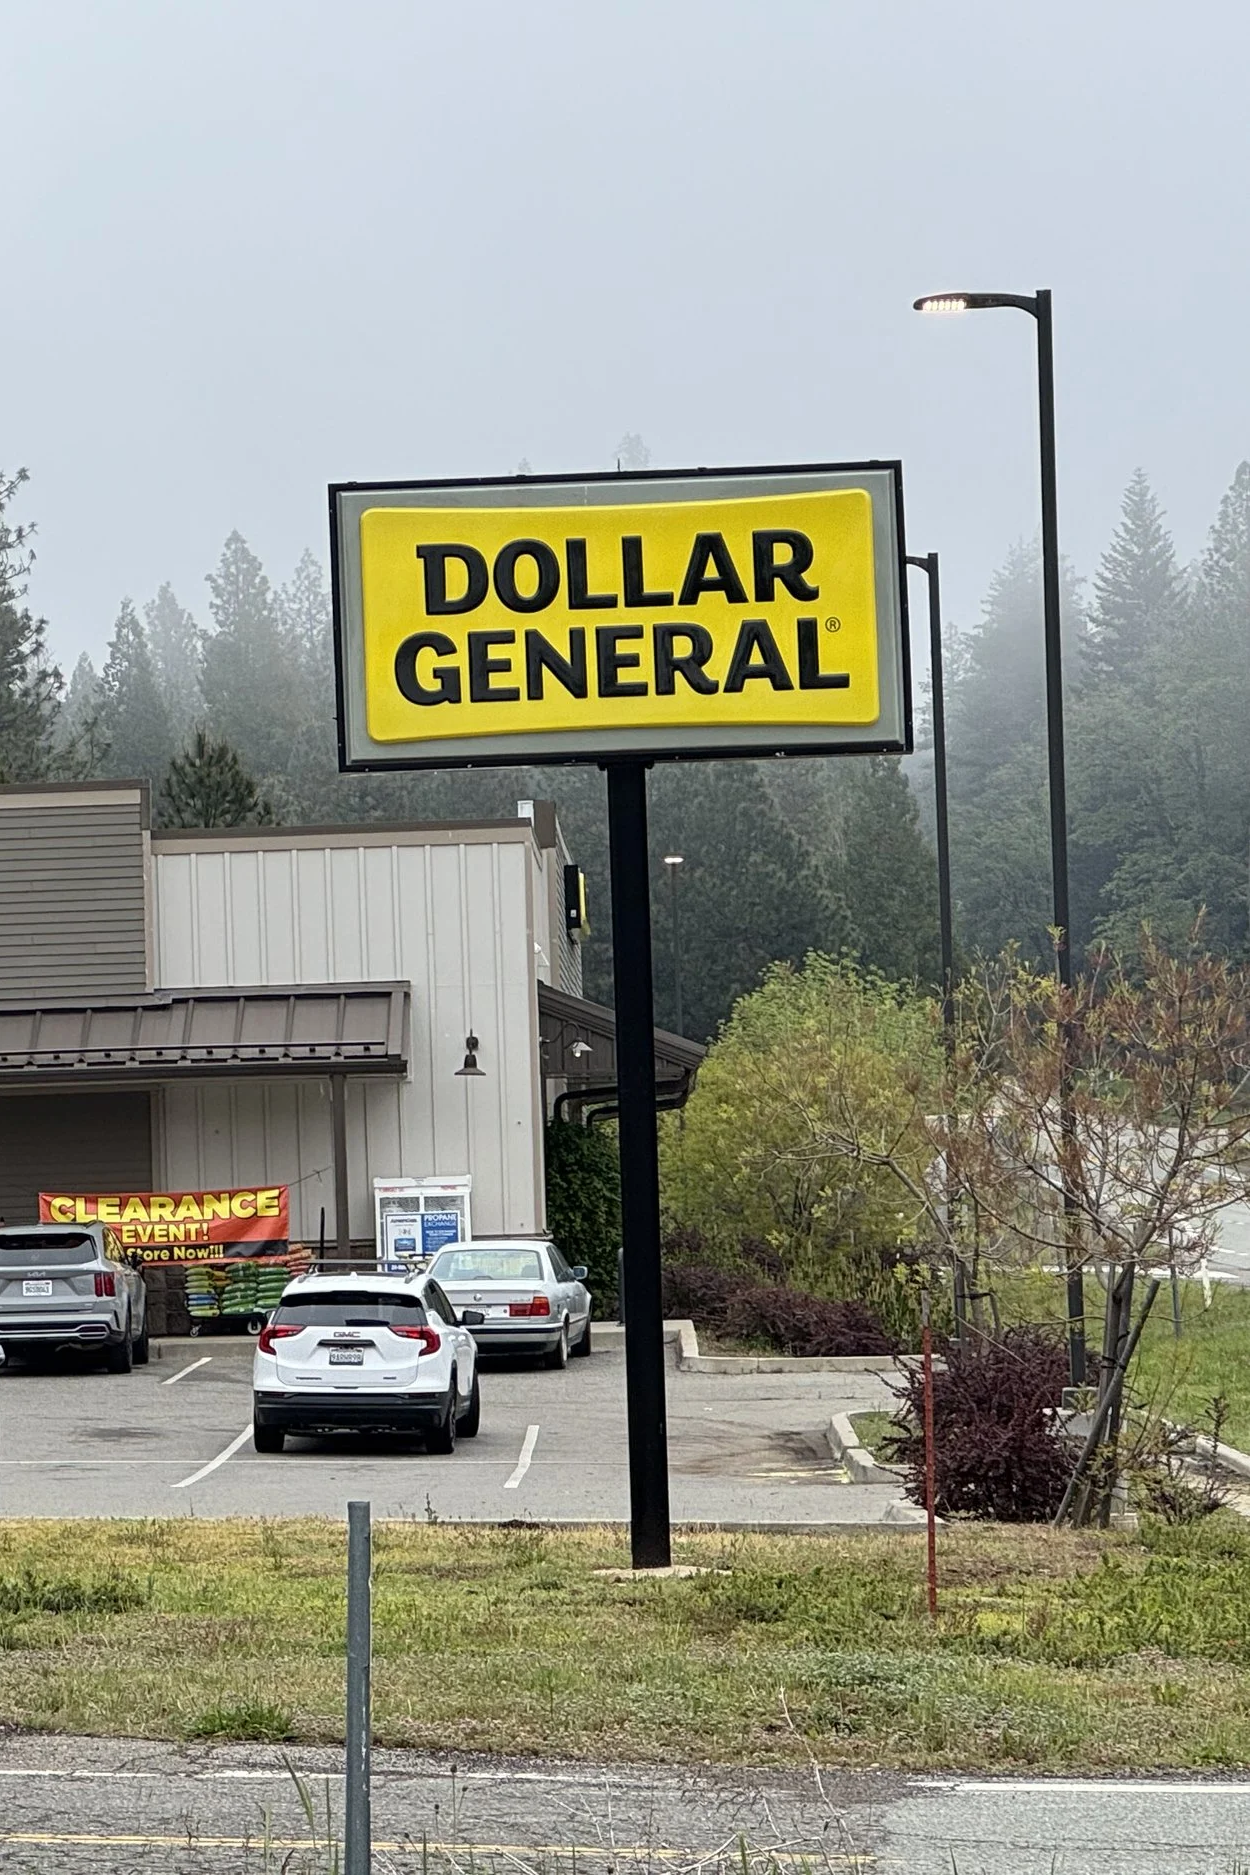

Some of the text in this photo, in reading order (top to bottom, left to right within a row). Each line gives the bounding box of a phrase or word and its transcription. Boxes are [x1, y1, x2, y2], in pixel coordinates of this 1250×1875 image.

[415, 529, 820, 616] DOLLAR
[394, 617, 851, 708] GENERAL
[49, 1188, 280, 1224] CLEARANCE
[424, 1213, 457, 1222] PROPANE
[121, 1222, 210, 1244] EVENT!
[173, 1243, 225, 1261] Now!!!
